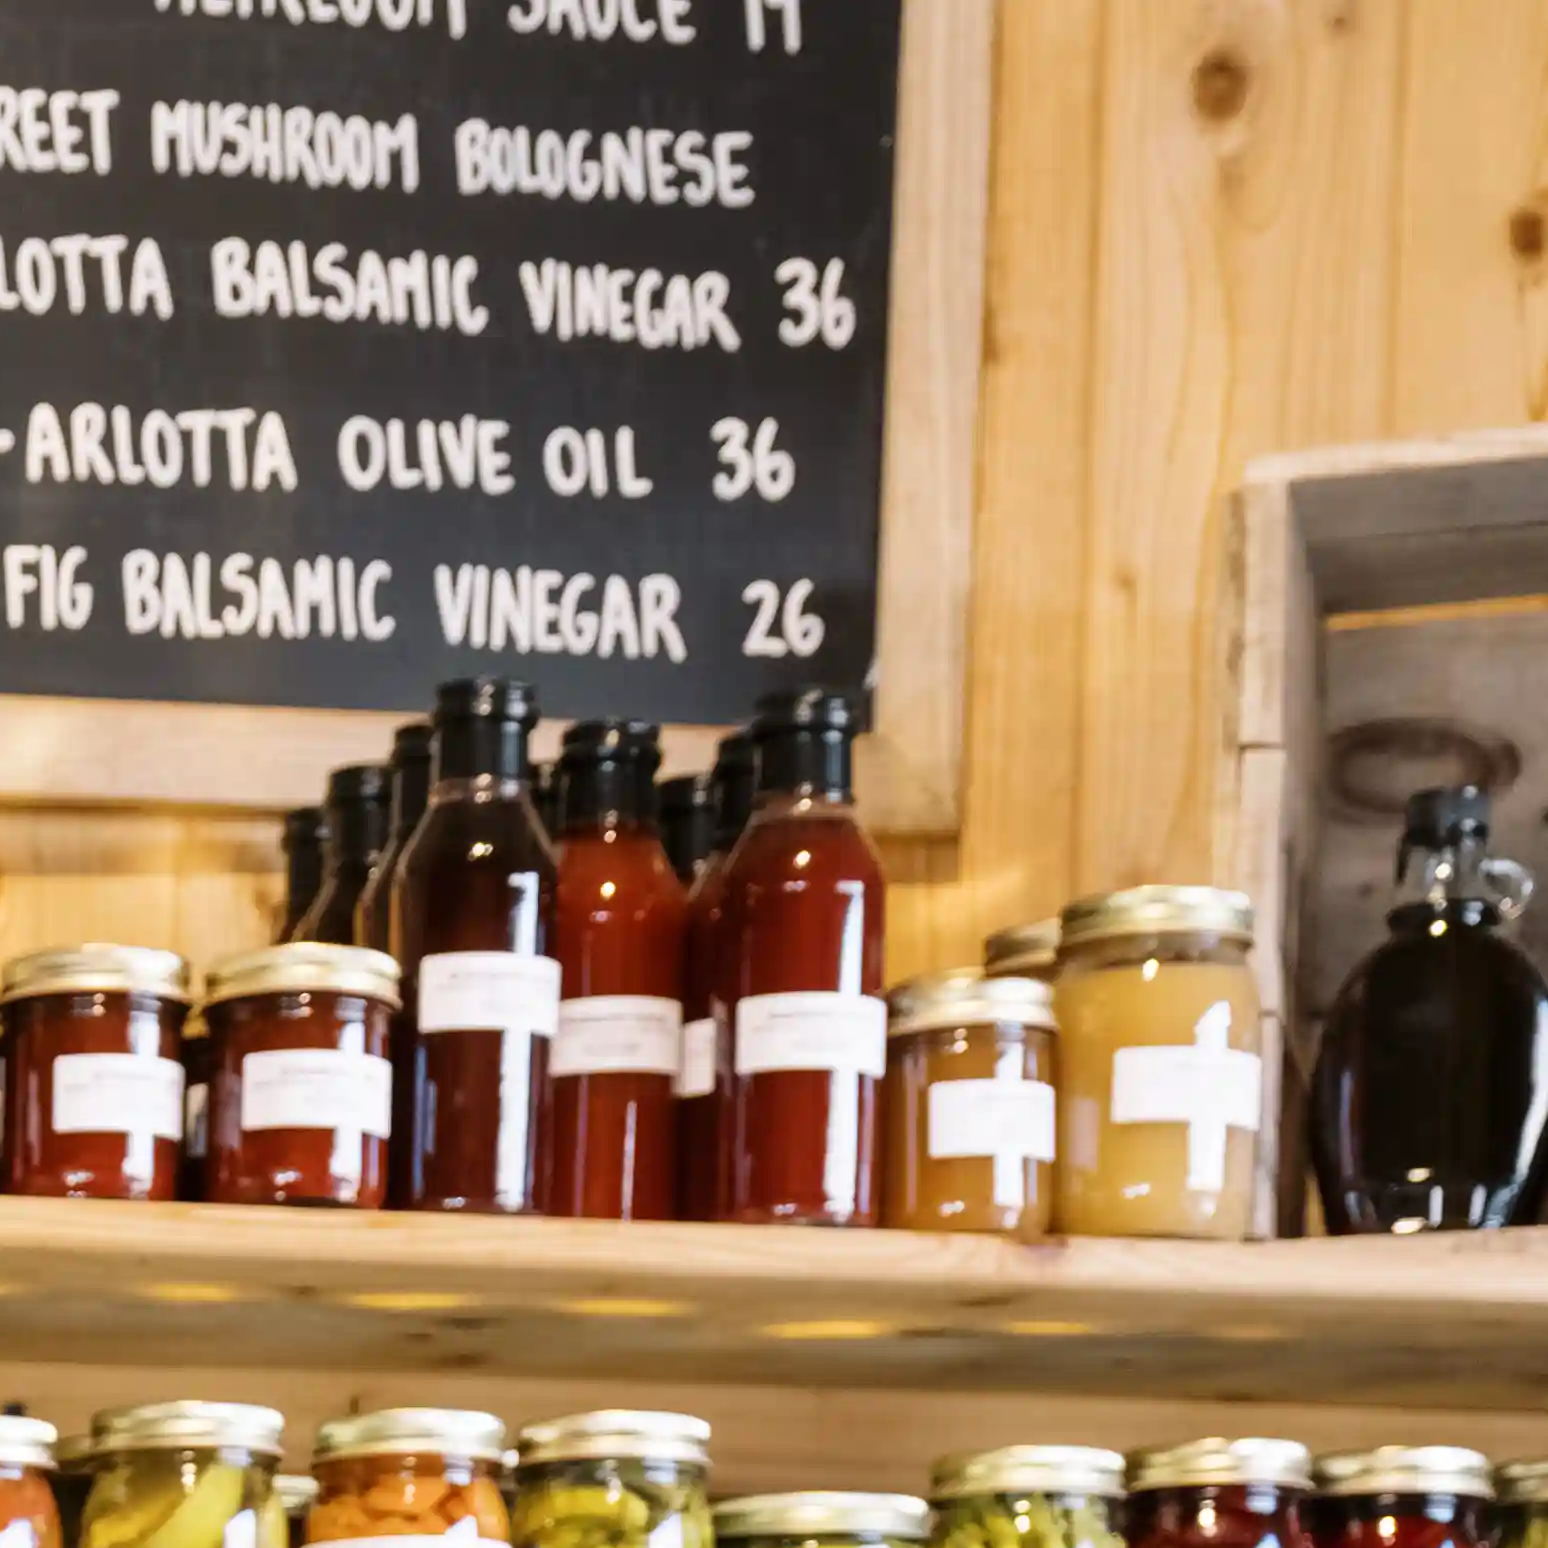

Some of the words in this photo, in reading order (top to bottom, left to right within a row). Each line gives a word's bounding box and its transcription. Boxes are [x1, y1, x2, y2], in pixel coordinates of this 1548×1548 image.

[150, 98, 420, 194] MUSHROOM
[454, 117, 757, 208] BOLOGNESE
[210, 236, 490, 335] BALSAMIC
[519, 257, 742, 353] VINEGAR
[774, 256, 857, 350] 36
[23, 402, 299, 492] ARLOTTA
[336, 414, 516, 497] OLIVE
[542, 426, 654, 499] OIL
[709, 416, 797, 503] 36
[3, 543, 95, 630] FIG
[121, 548, 397, 640] BALSAMIC
[433, 563, 688, 663] VINEGAR
[740, 578, 825, 657] 26
